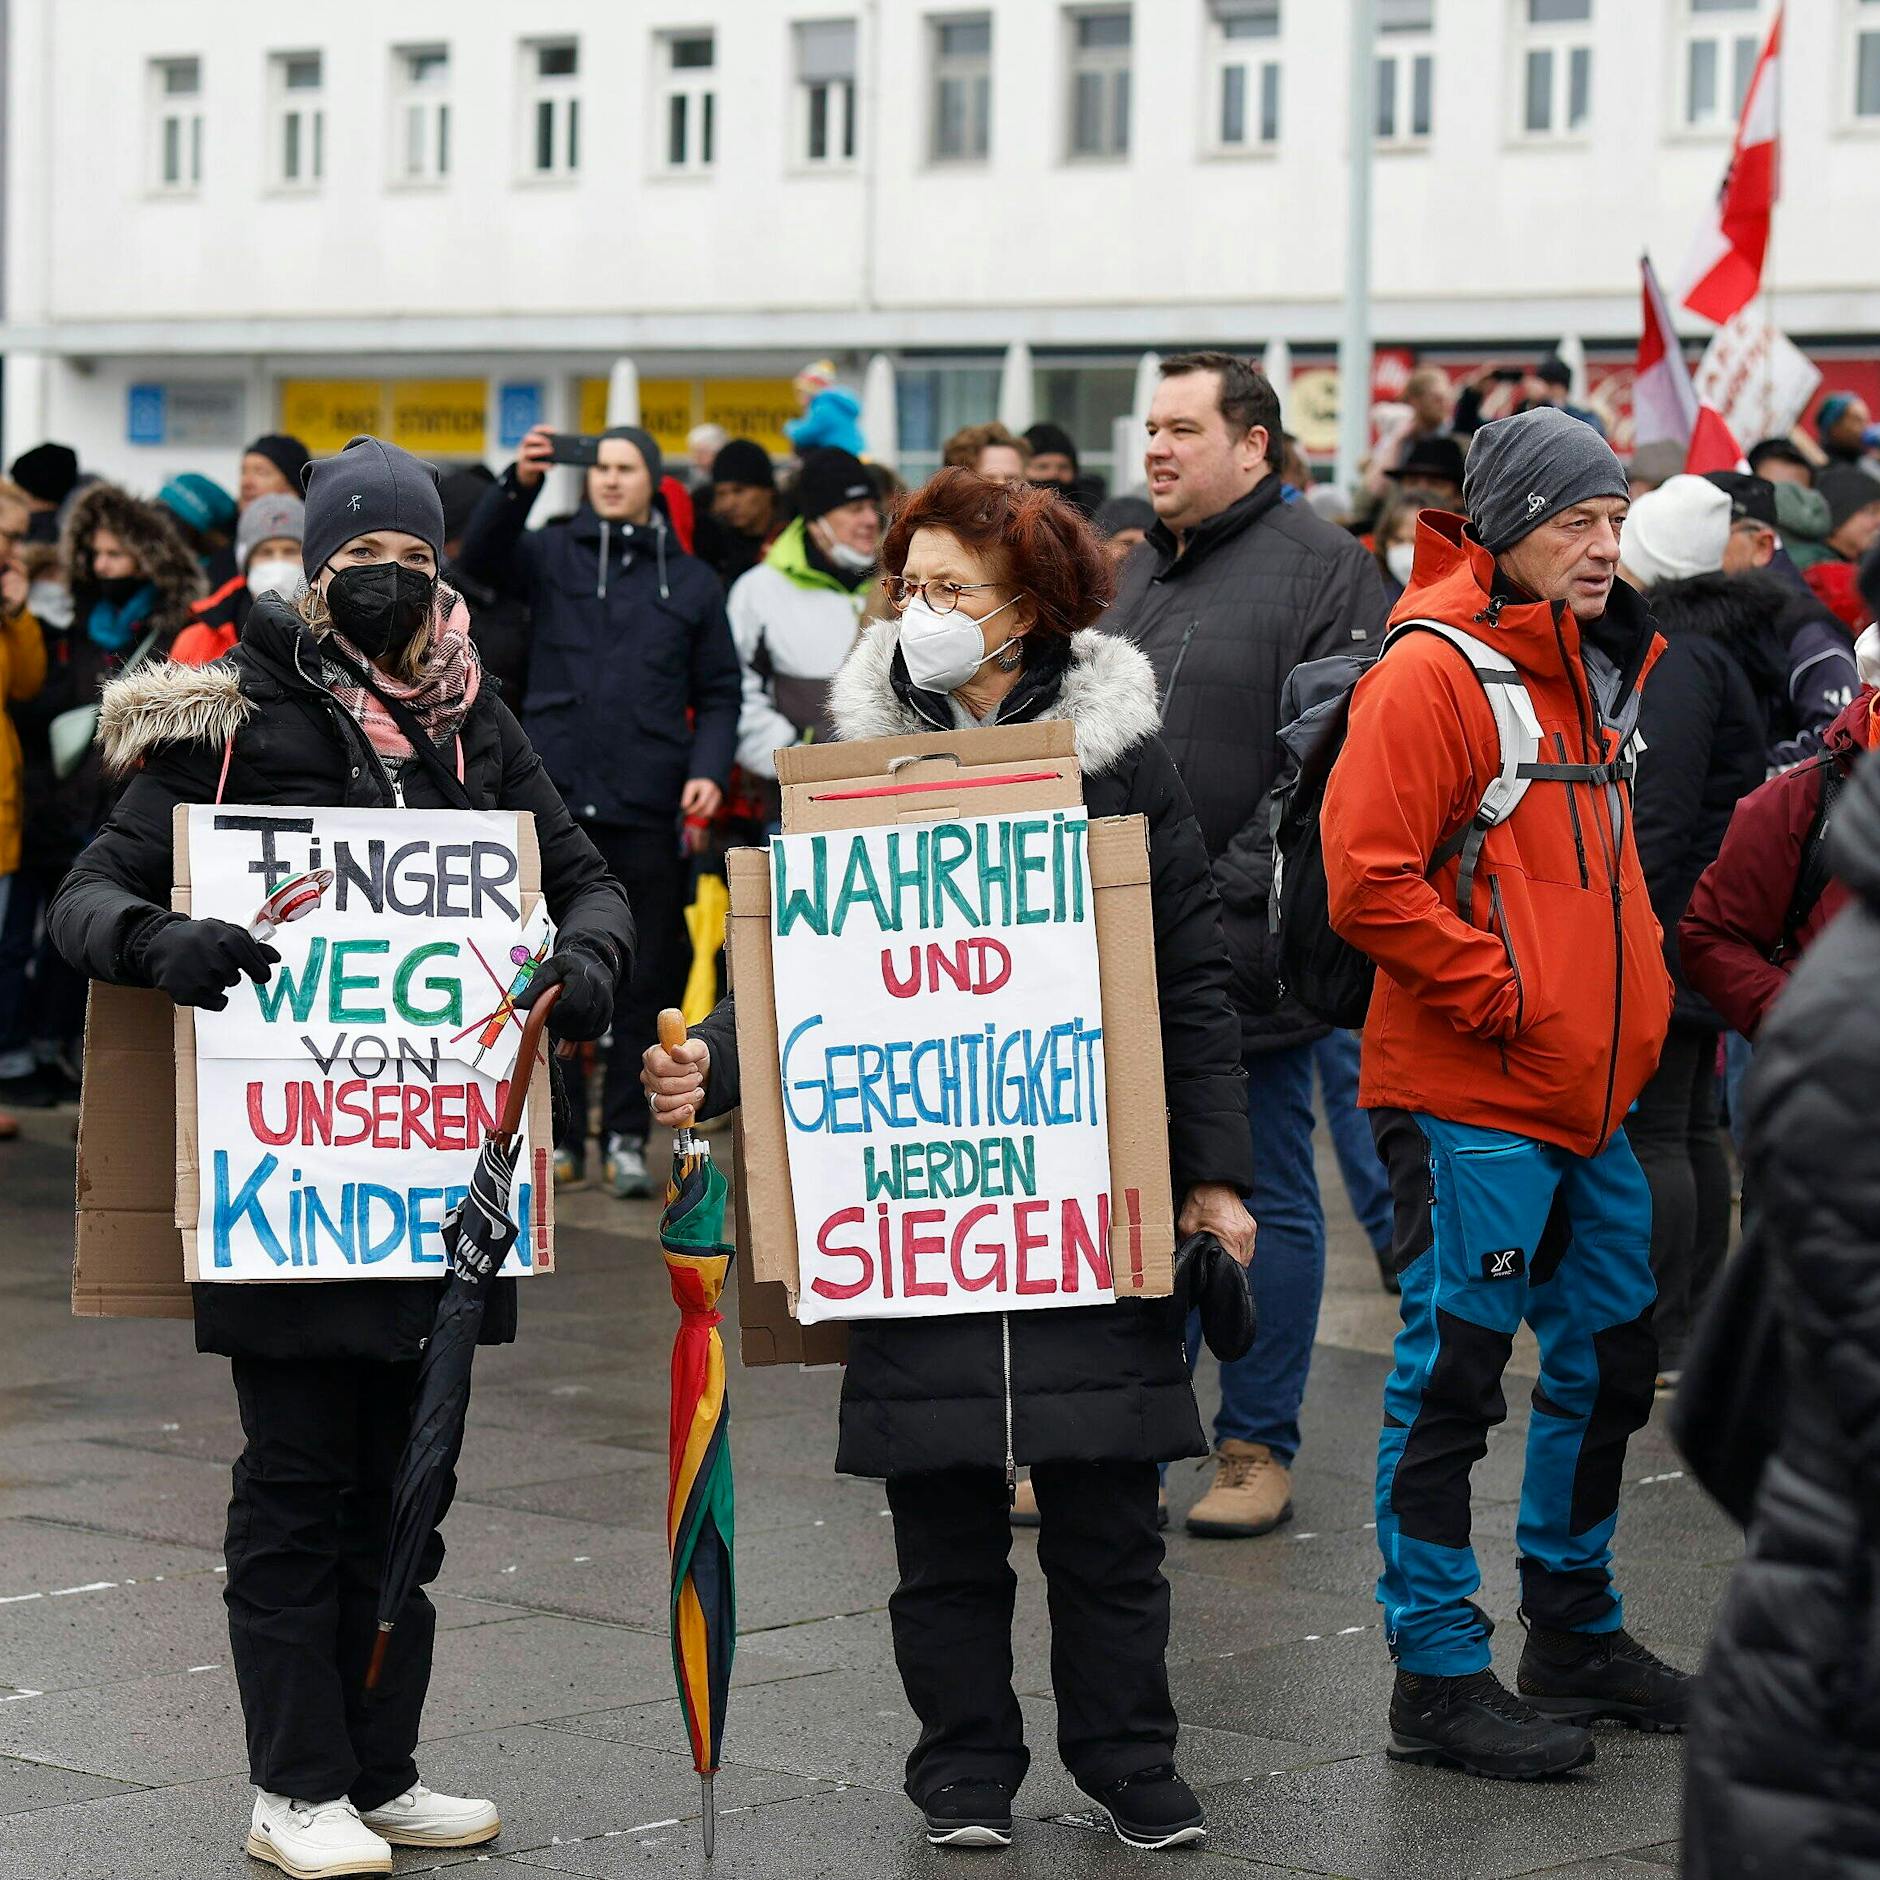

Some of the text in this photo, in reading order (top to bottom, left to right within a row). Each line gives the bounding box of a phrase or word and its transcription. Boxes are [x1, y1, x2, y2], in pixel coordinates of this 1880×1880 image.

[250, 937, 463, 1027] WEG
[881, 937, 1012, 998] UND
[301, 1033, 440, 1083] VON
[247, 1080, 510, 1150] UNSEREN
[864, 1136, 1036, 1201] WERDEN
